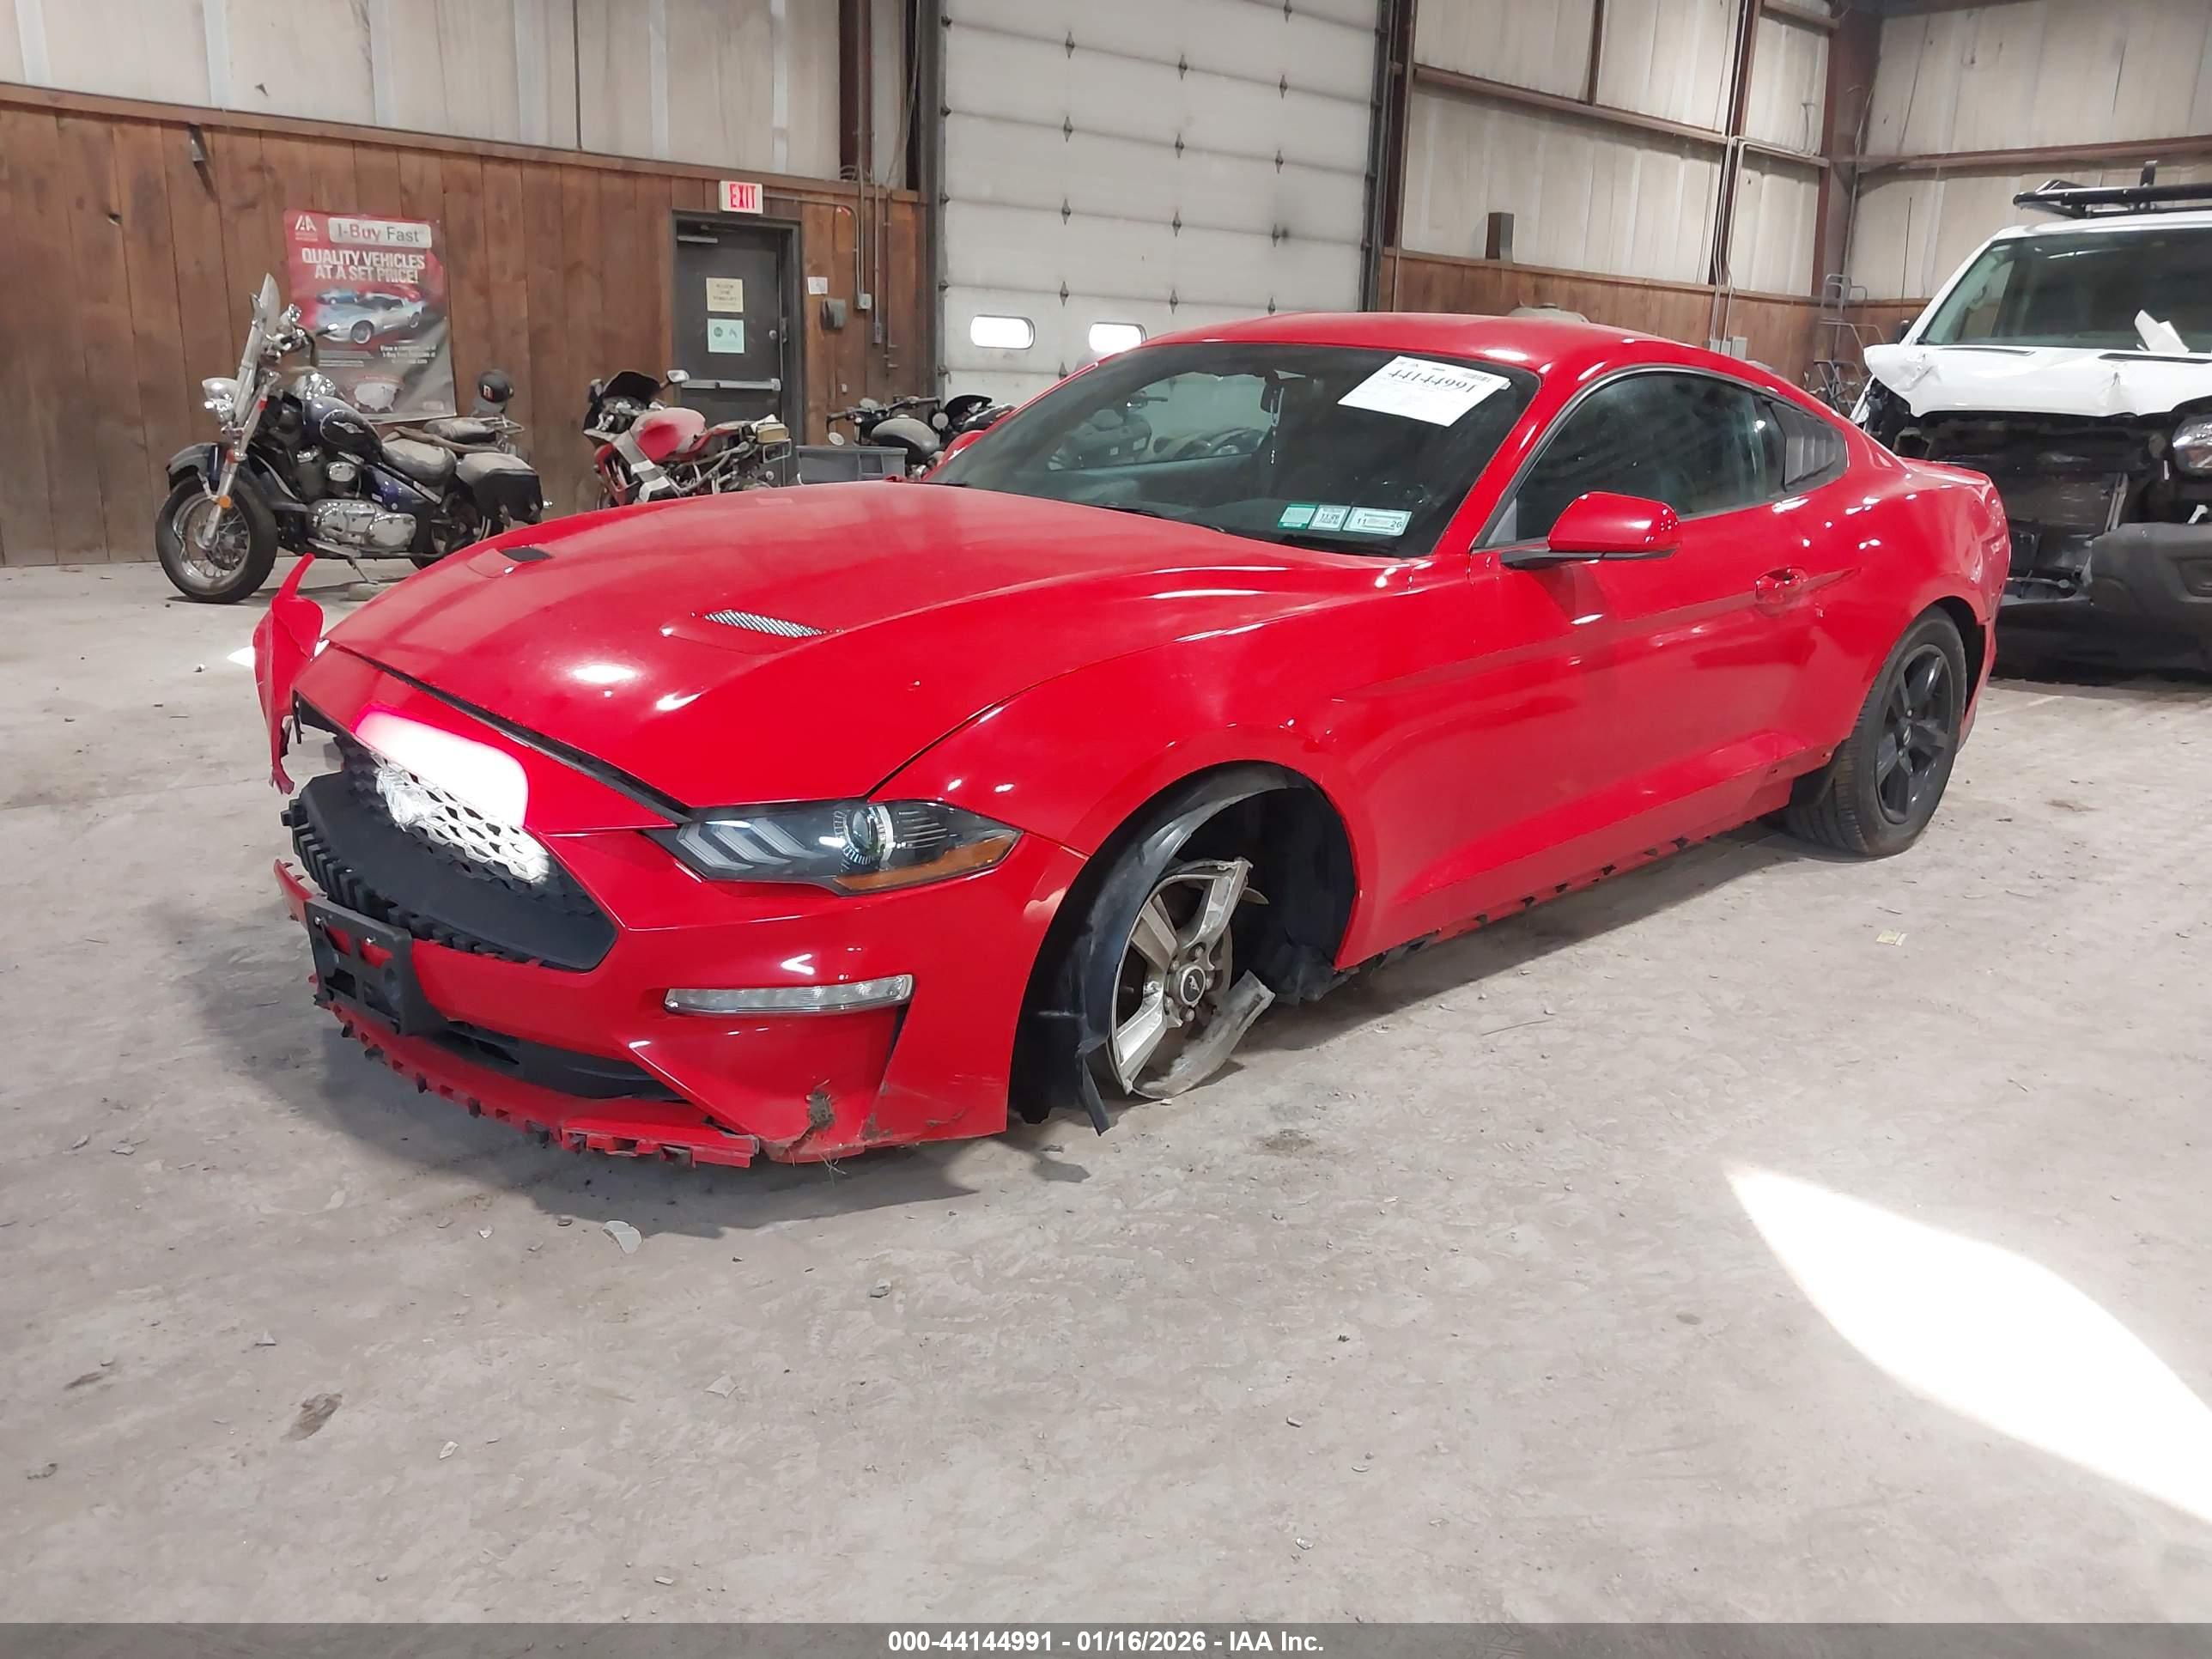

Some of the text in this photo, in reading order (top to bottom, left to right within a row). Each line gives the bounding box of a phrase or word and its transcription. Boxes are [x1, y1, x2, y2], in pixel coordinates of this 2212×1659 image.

[730, 184, 756, 209] EXIT
[337, 223, 380, 241] I-Buy
[386, 226, 420, 242] Fast
[302, 247, 426, 270] QUALITY VEHICLES
[315, 264, 419, 284] AT A SET PRICE!
[1388, 369, 1478, 392] 44144991
